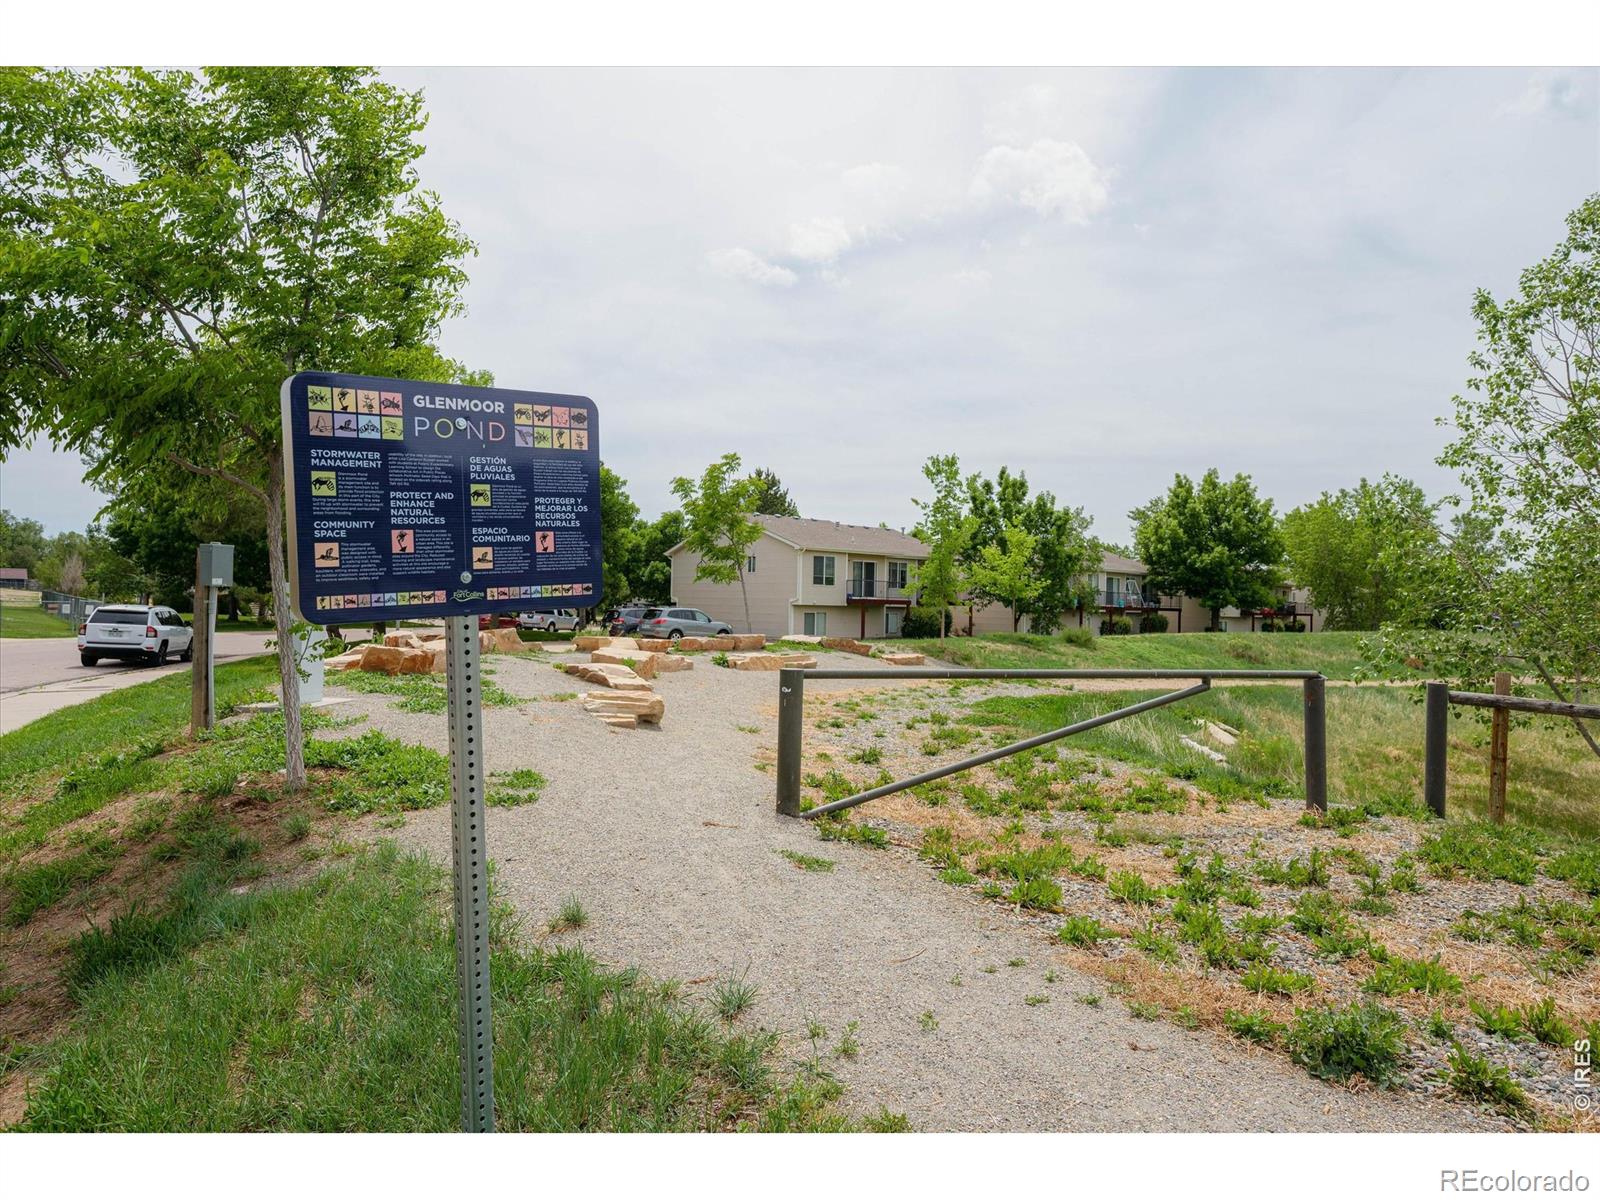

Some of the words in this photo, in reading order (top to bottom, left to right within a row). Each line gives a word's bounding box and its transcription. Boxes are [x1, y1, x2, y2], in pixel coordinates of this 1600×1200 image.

[413, 395, 504, 414] GLENMOOR
[414, 416, 506, 441] POND
[310, 449, 380, 459] STORMWATER
[311, 459, 382, 468] MANAGEMENT
[470, 456, 506, 464] GESTIÓN
